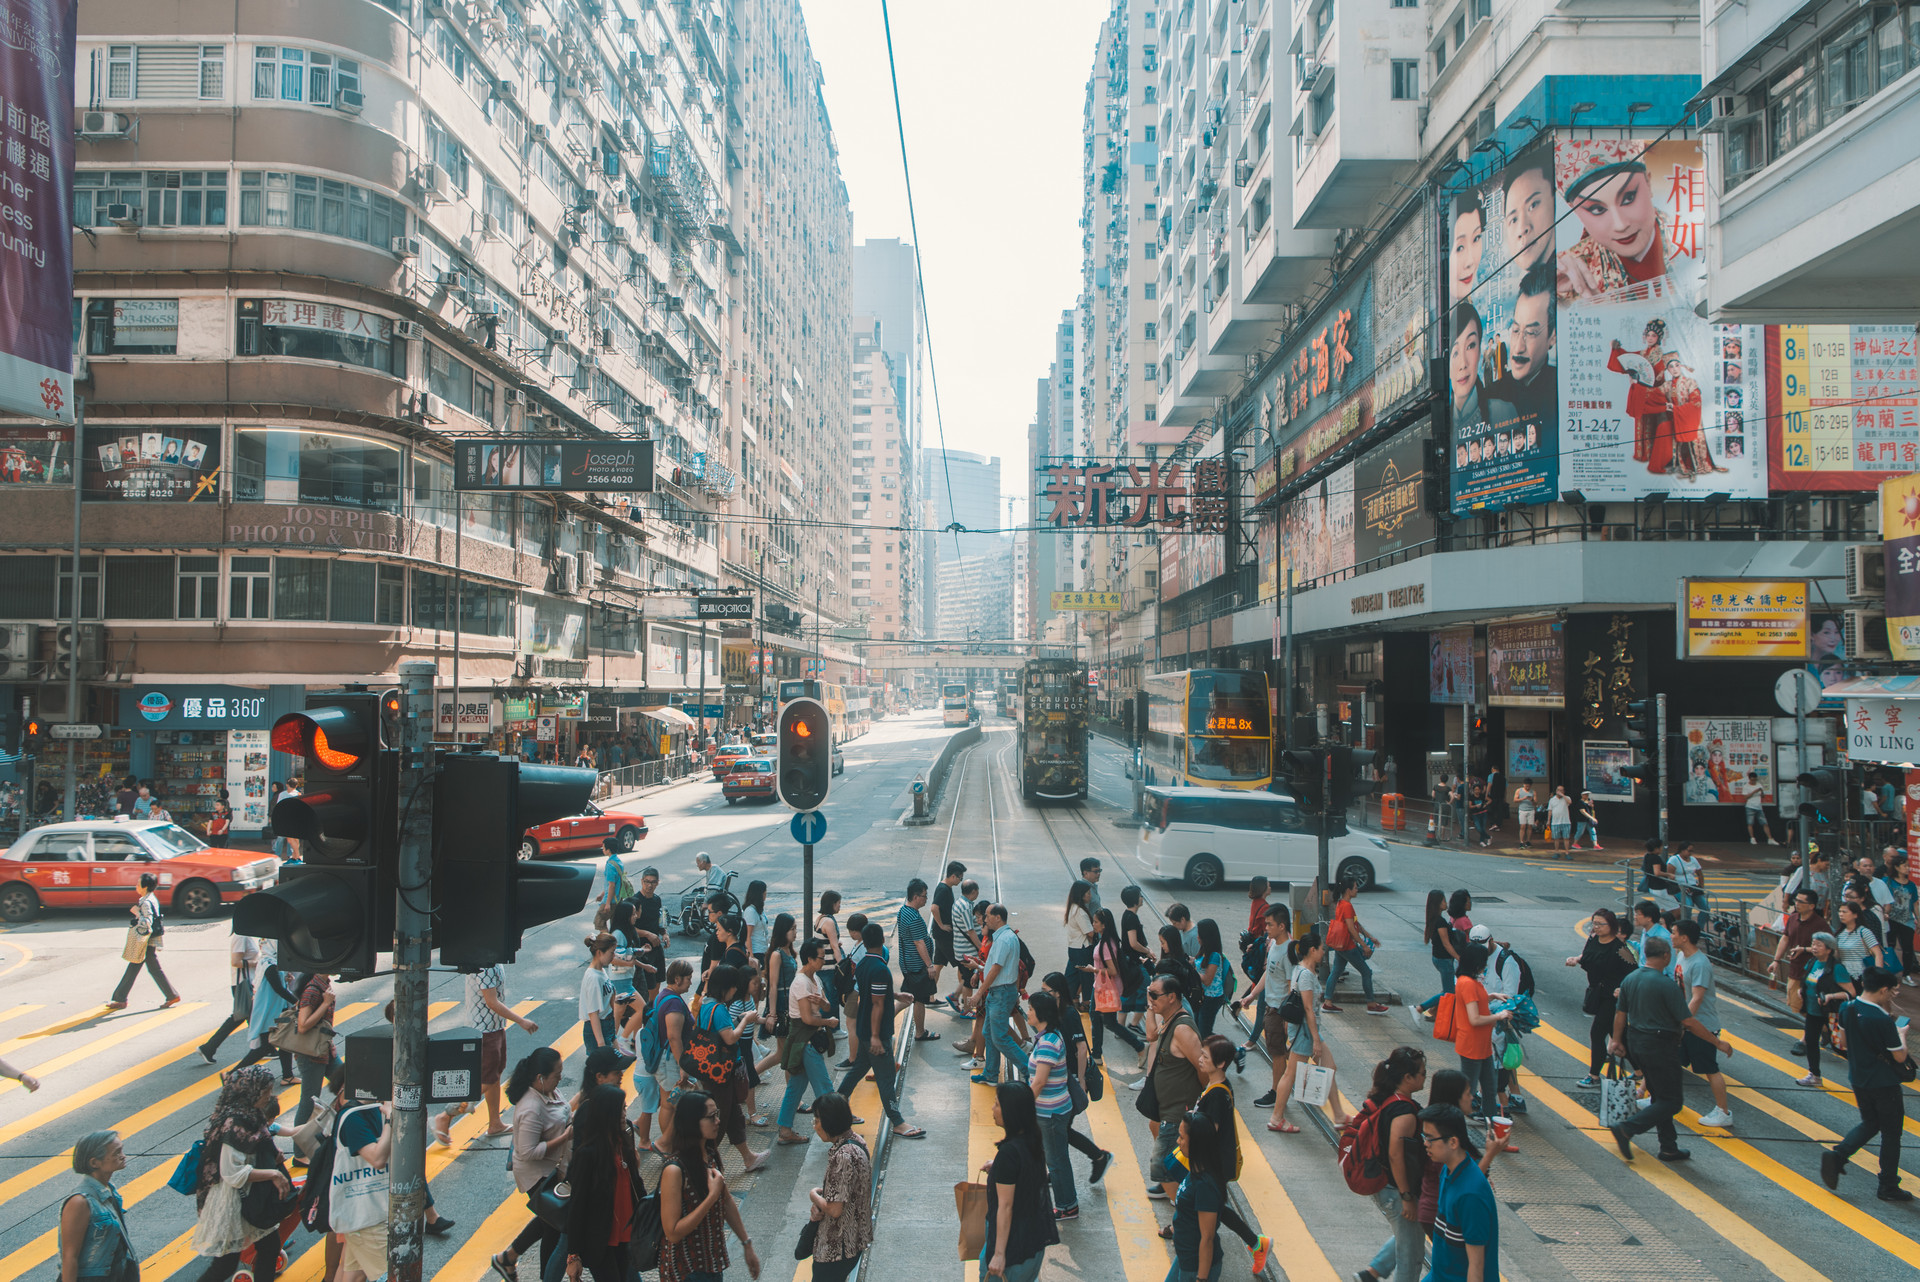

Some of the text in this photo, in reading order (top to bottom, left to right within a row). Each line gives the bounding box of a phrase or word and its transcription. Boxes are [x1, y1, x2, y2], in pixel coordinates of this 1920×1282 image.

[122, 301, 179, 311] 2562319
[120, 314, 178, 324] 9348658
[1567, 418, 1621, 432] 21-24.7
[1813, 414, 1849, 430] 26-29日
[467, 447, 477, 483] 攝影製作
[587, 476, 634, 484] 2566 4020
[150, 489, 173, 497] 4020
[334, 494, 361, 504] Wedding
[1047, 461, 1187, 528] 新光
[282, 507, 374, 530] JOSEPH
[229, 525, 316, 544] PHOTO
[326, 528, 343, 546] &
[1351, 583, 1425, 615] SUNBEAM THEATRE
[1711, 593, 1804, 606] 陽光女傭中心
[441, 703, 488, 715] 優の良品
[1853, 705, 1920, 734] 安寧
[1705, 720, 1768, 742] 金玉觀世音
[1854, 734, 1914, 750] ON LING
